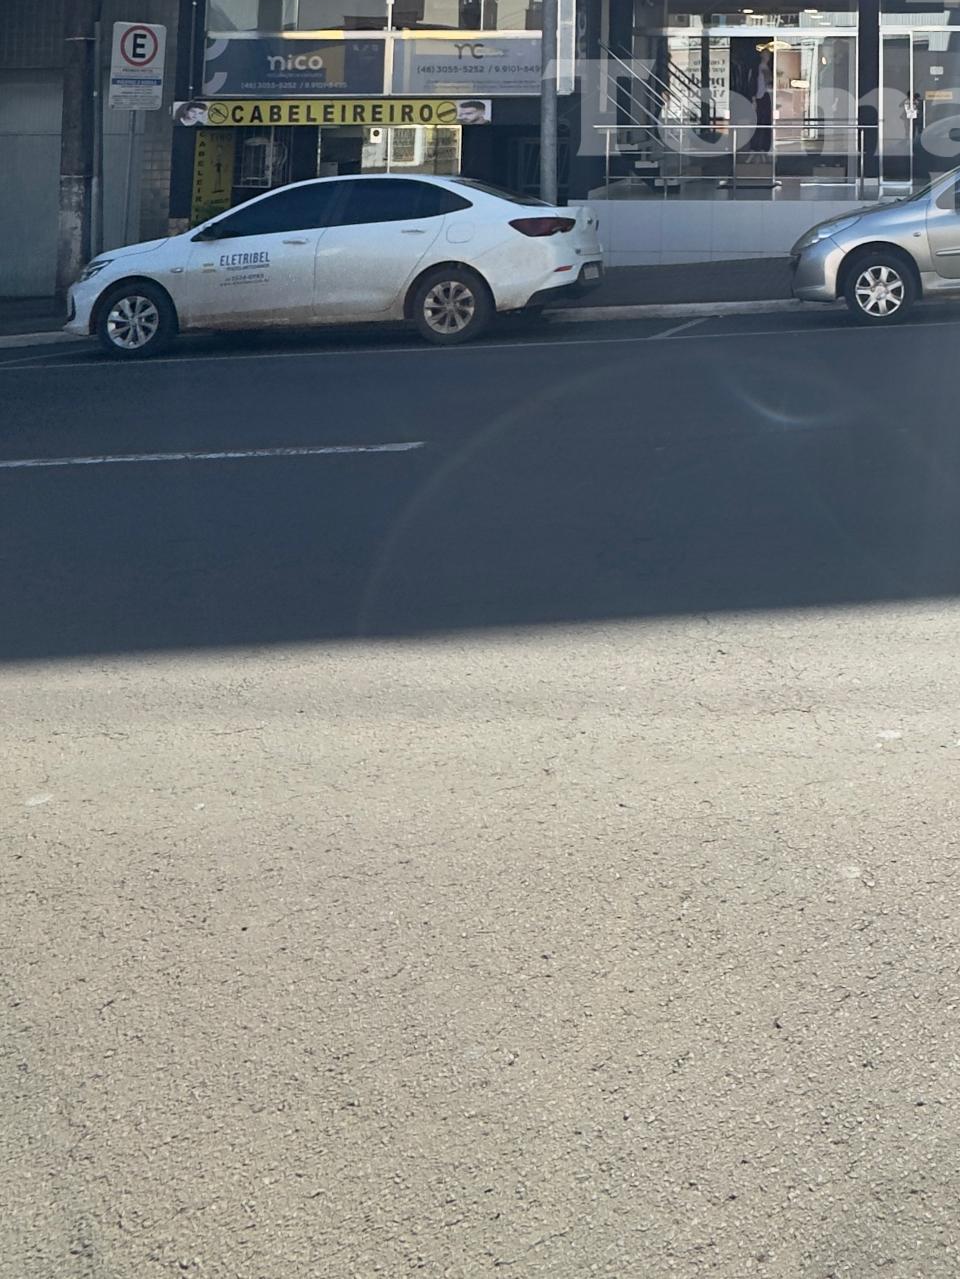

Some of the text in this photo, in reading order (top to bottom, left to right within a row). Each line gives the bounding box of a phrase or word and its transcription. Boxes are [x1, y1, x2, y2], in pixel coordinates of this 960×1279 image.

[132, 33, 147, 59] E
[267, 54, 323, 71] nico
[231, 104, 433, 123] CABELEIREIRO
[220, 251, 270, 266] ELETRIBEL
